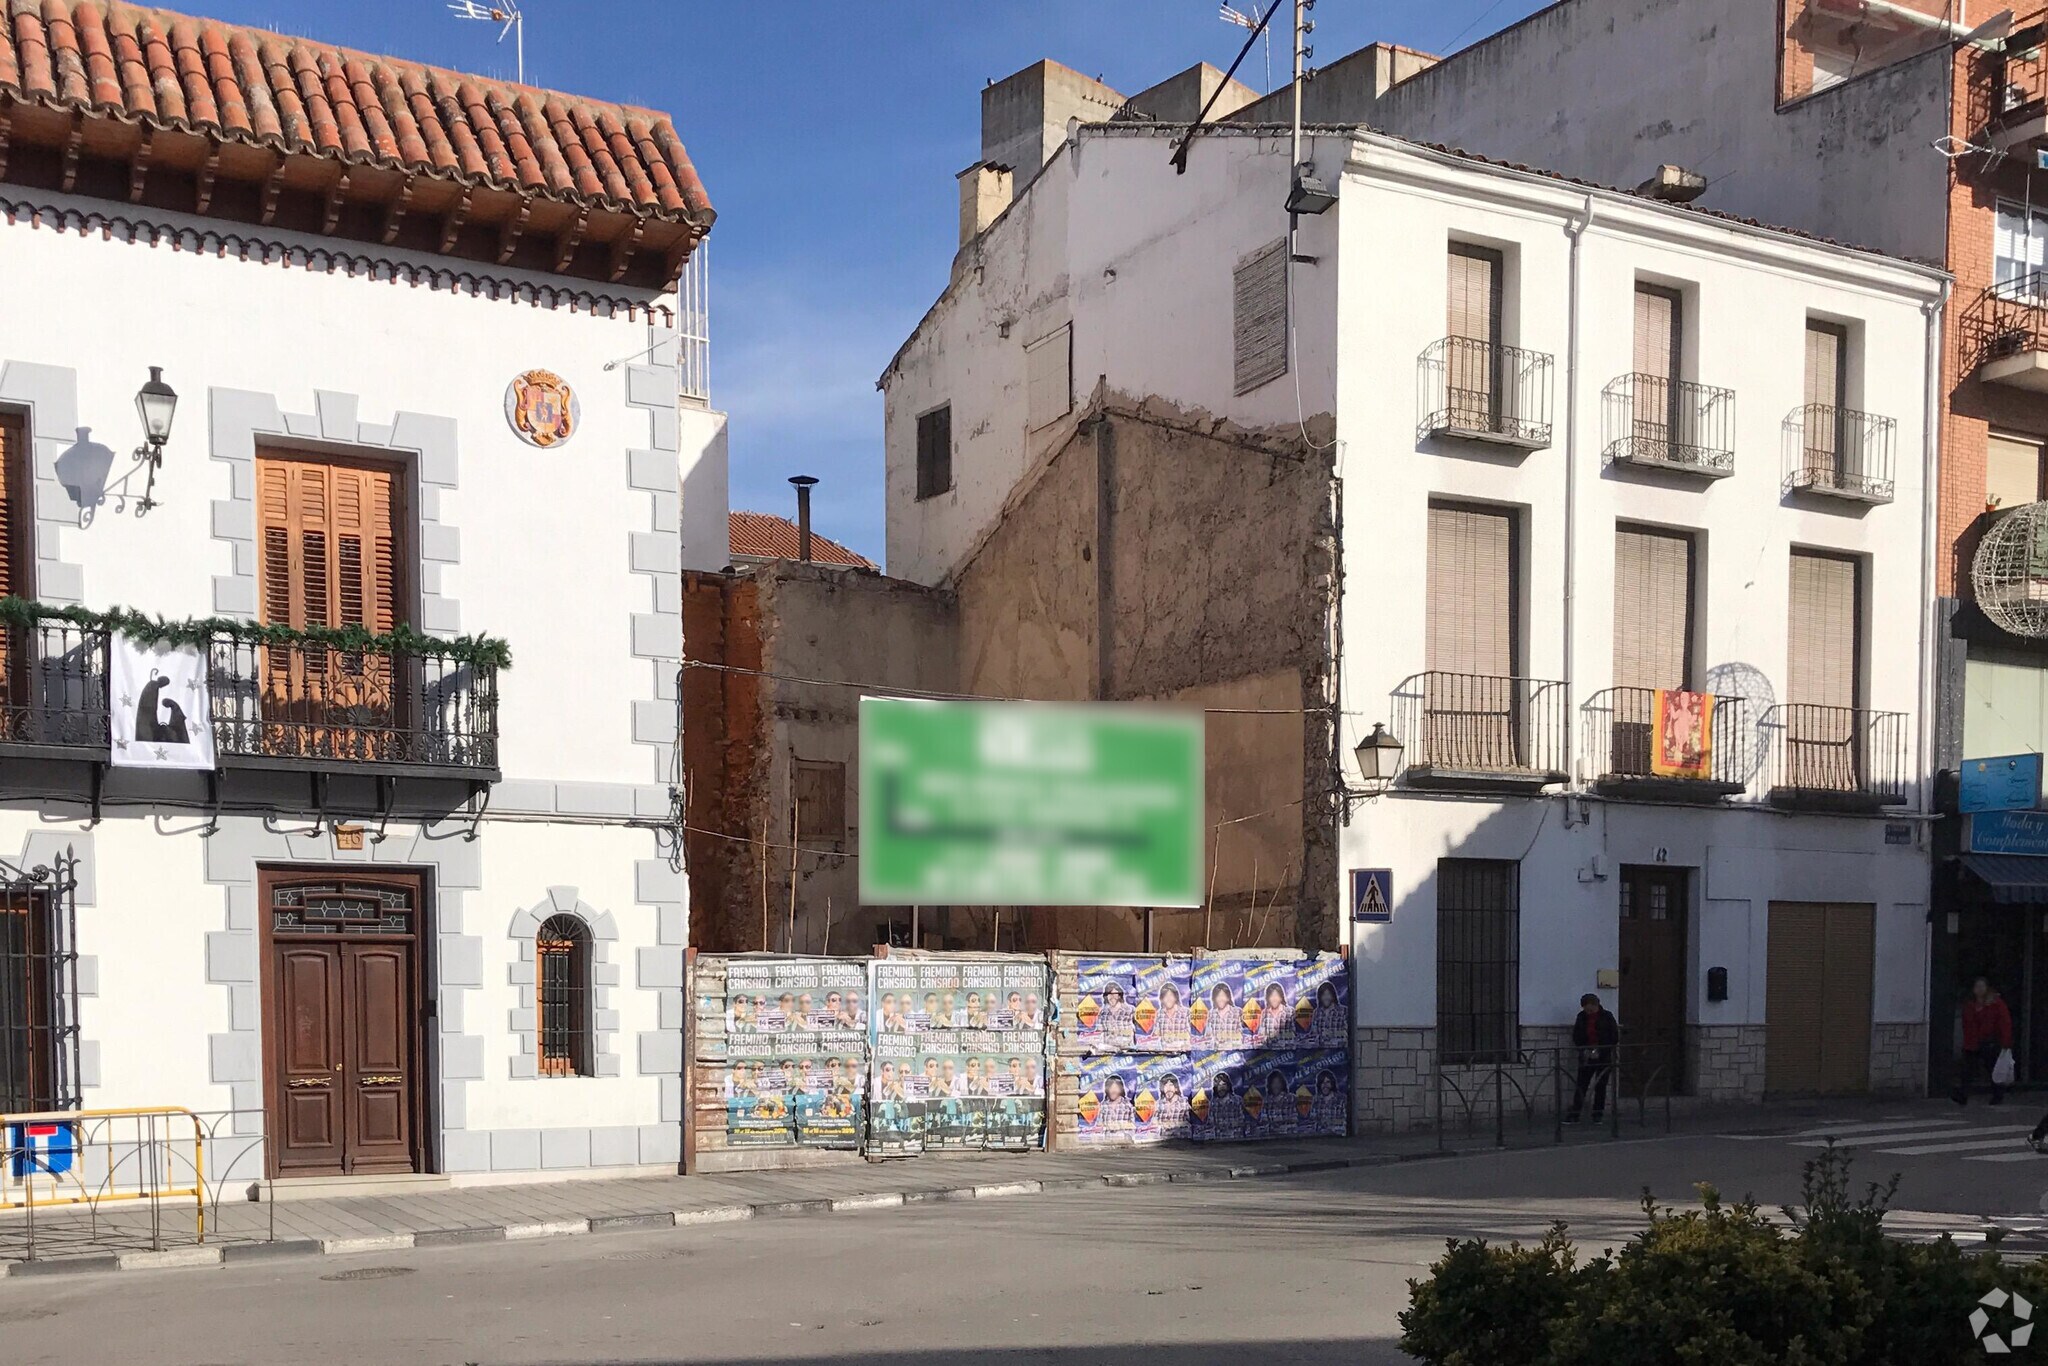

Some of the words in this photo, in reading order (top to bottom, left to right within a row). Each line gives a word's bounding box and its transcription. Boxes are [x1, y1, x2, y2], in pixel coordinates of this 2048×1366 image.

[728, 966, 769, 978] FAEMINO
[775, 965, 815, 976] FAEMINO
[822, 964, 860, 976] FAEMINO
[878, 966, 914, 977] FAEMINO
[920, 966, 957, 977] FAEMINO
[962, 966, 999, 976] FAEMINO
[1004, 966, 1040, 976] FAEMINO
[728, 978, 771, 989] CANSADO
[775, 977, 818, 988] CANSADO
[822, 976, 864, 987] CANSADO
[878, 978, 916, 988] CANSADO
[920, 978, 960, 988] CANSADO
[962, 977, 1002, 988] CANSADO
[1004, 976, 1043, 988] CANSADO
[729, 1034, 769, 1045] FAEMINO
[775, 1032, 815, 1044] FAEMINO
[822, 1032, 860, 1043] FAEMINO
[878, 1034, 914, 1046] FAEMINO
[1002, 1032, 1040, 1043] FAEMINO
[728, 1044, 771, 1056] CANSADO
[775, 1043, 817, 1054] CANSADO
[821, 1042, 864, 1053] CANSADO
[878, 1046, 916, 1058] CANSADO
[920, 1042, 960, 1054] CANSADO
[1002, 1042, 1042, 1053] CANSADO
